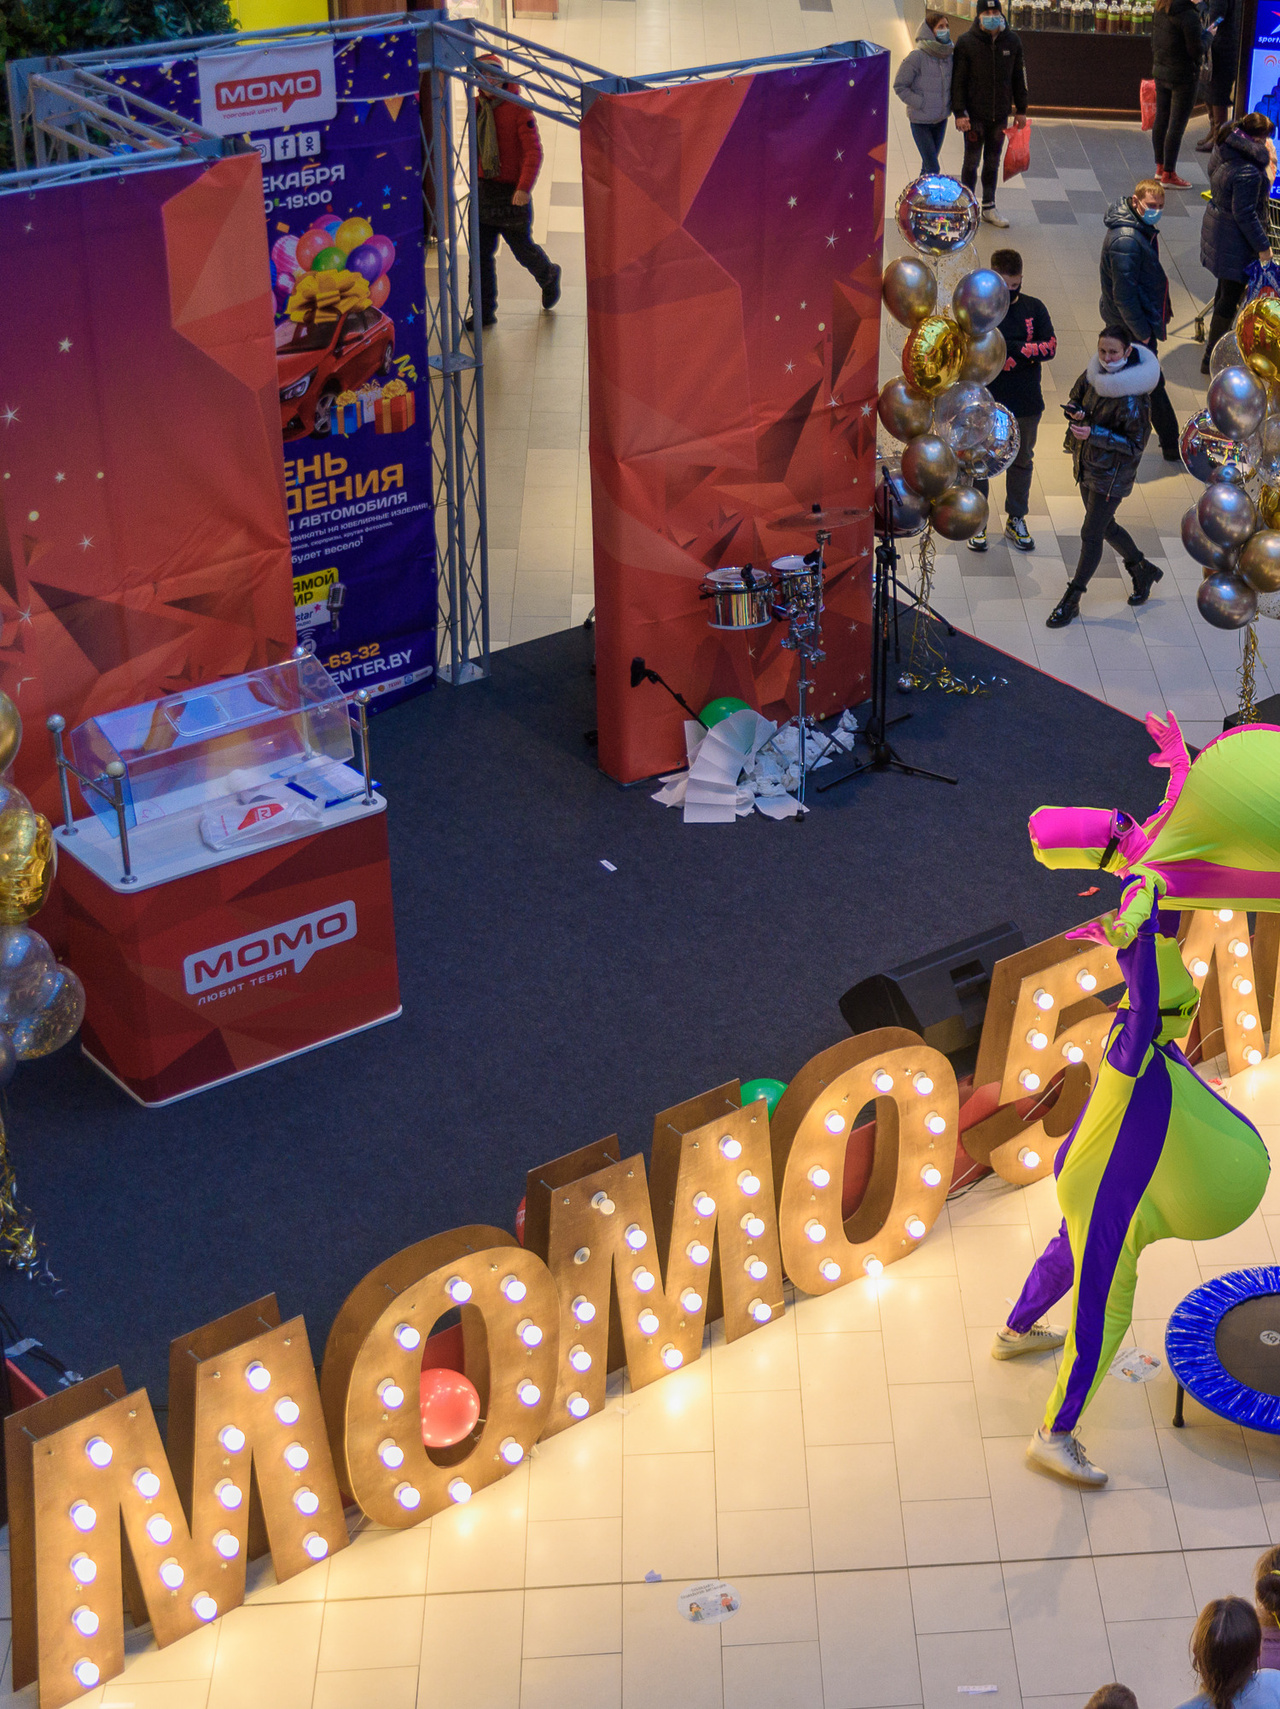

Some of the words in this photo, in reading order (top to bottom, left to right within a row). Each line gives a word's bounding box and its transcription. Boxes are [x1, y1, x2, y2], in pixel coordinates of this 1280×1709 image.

[299, 491, 408, 529] АВТОМОБИЛЯ
[340, 512, 389, 530] ЮВЕЛИРНЫЕ
[291, 550, 321, 564] будет
[324, 535, 364, 556] весело!
[194, 912, 348, 984] МОМО
[198, 983, 245, 1006] ЛЮБИТ
[250, 968, 288, 987] ТЕБЯ!
